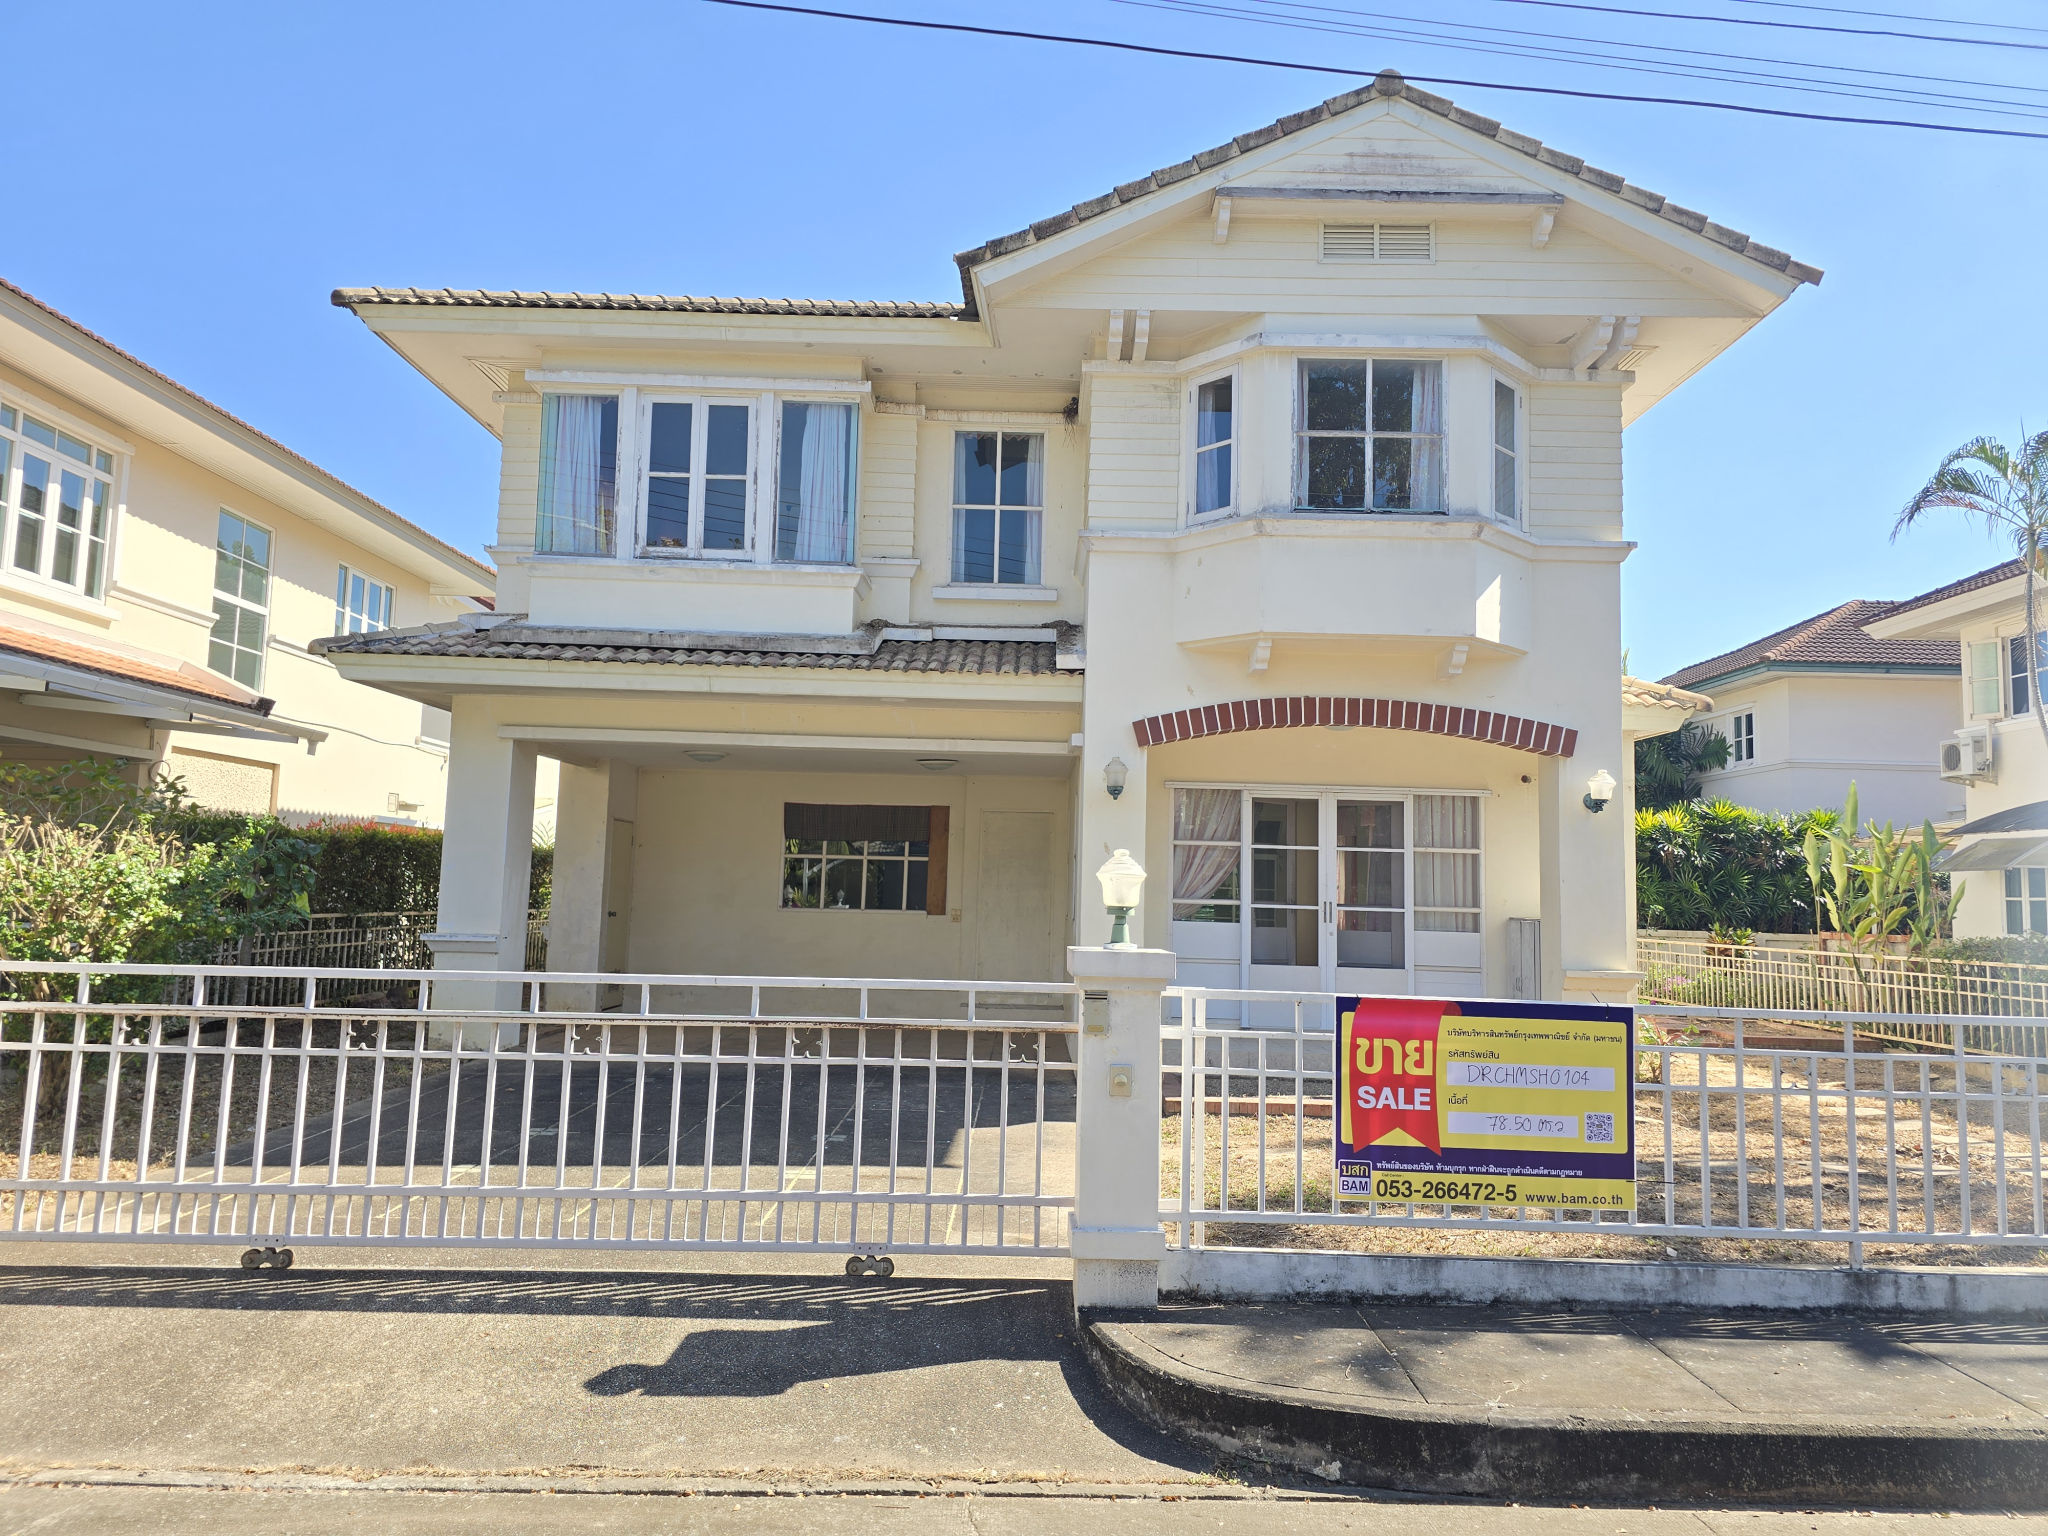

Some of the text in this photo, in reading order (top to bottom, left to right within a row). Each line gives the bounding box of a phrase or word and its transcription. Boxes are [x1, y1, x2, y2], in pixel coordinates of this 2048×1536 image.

[1447, 1028, 1623, 1045] บริษัทบริหารสินทรัพย์กรุงเทพพาณิชย์ จำกัด (มหาชน)
[1356, 1037, 1433, 1076] ขาย
[1448, 1050, 1500, 1060] รหัสทรัพย์สิน
[1357, 1085, 1431, 1111] SALE
[1448, 1093, 1468, 1105] เนื้อที่
[1486, 1115, 1532, 1132] 78.50
[1342, 1164, 1369, 1177] บสก
[1376, 1161, 1583, 1177] ทรัพย์สินของบริษัท ห้ามบุกรุก หากฝ่าฝืนจะถูกดำเนินคดีตามกฎหมาย
[1342, 1180, 1368, 1192] BAM
[1376, 1179, 1623, 1206] 053-266472-5 www.bam.co.th
